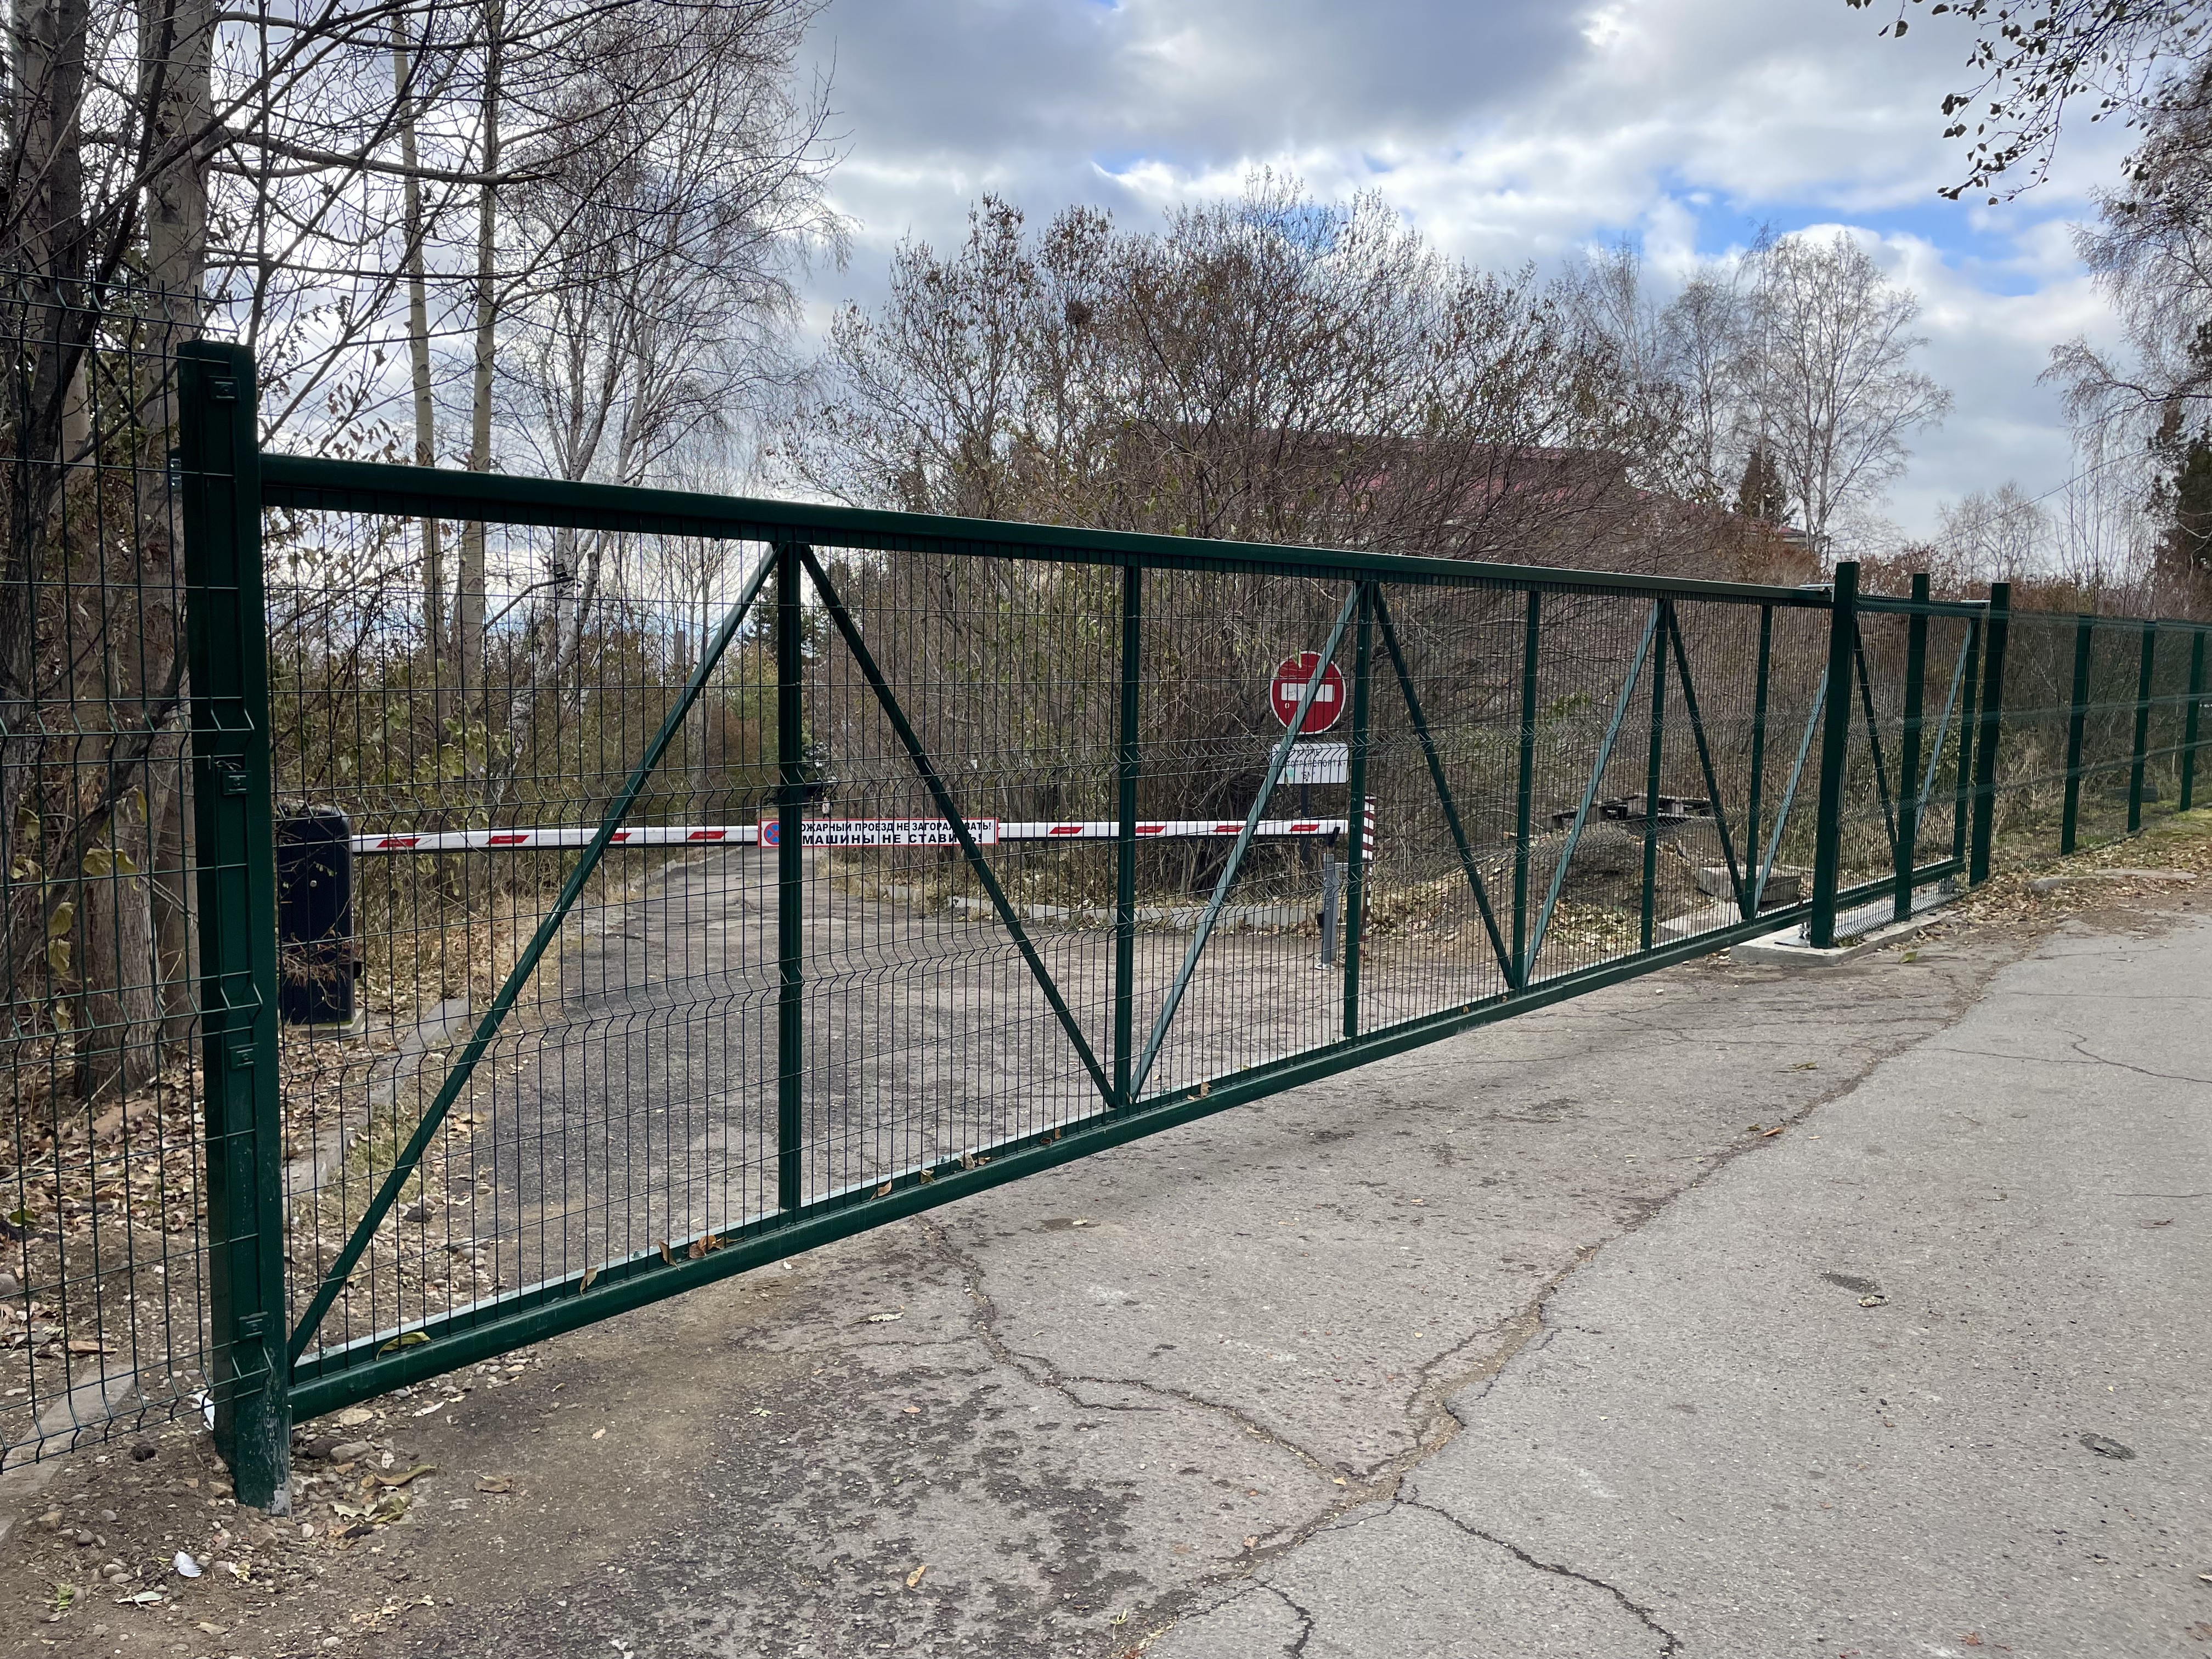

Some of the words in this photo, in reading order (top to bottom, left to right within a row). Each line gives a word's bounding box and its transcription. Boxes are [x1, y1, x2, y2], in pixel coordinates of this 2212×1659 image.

[1286, 759, 1341, 768] ТОТРАНСПОРТА
[801, 821, 851, 832] ОЖАРНЫЙ
[855, 822, 894, 833] ПРОЕЗД
[896, 822, 909, 831] НЕ
[912, 822, 991, 831] ЗАГОРАВАТЬ!
[803, 834, 874, 844] МАШИНЫ
[882, 834, 901, 844] НЕ
[909, 833, 982, 843] СТАВИЬ!
